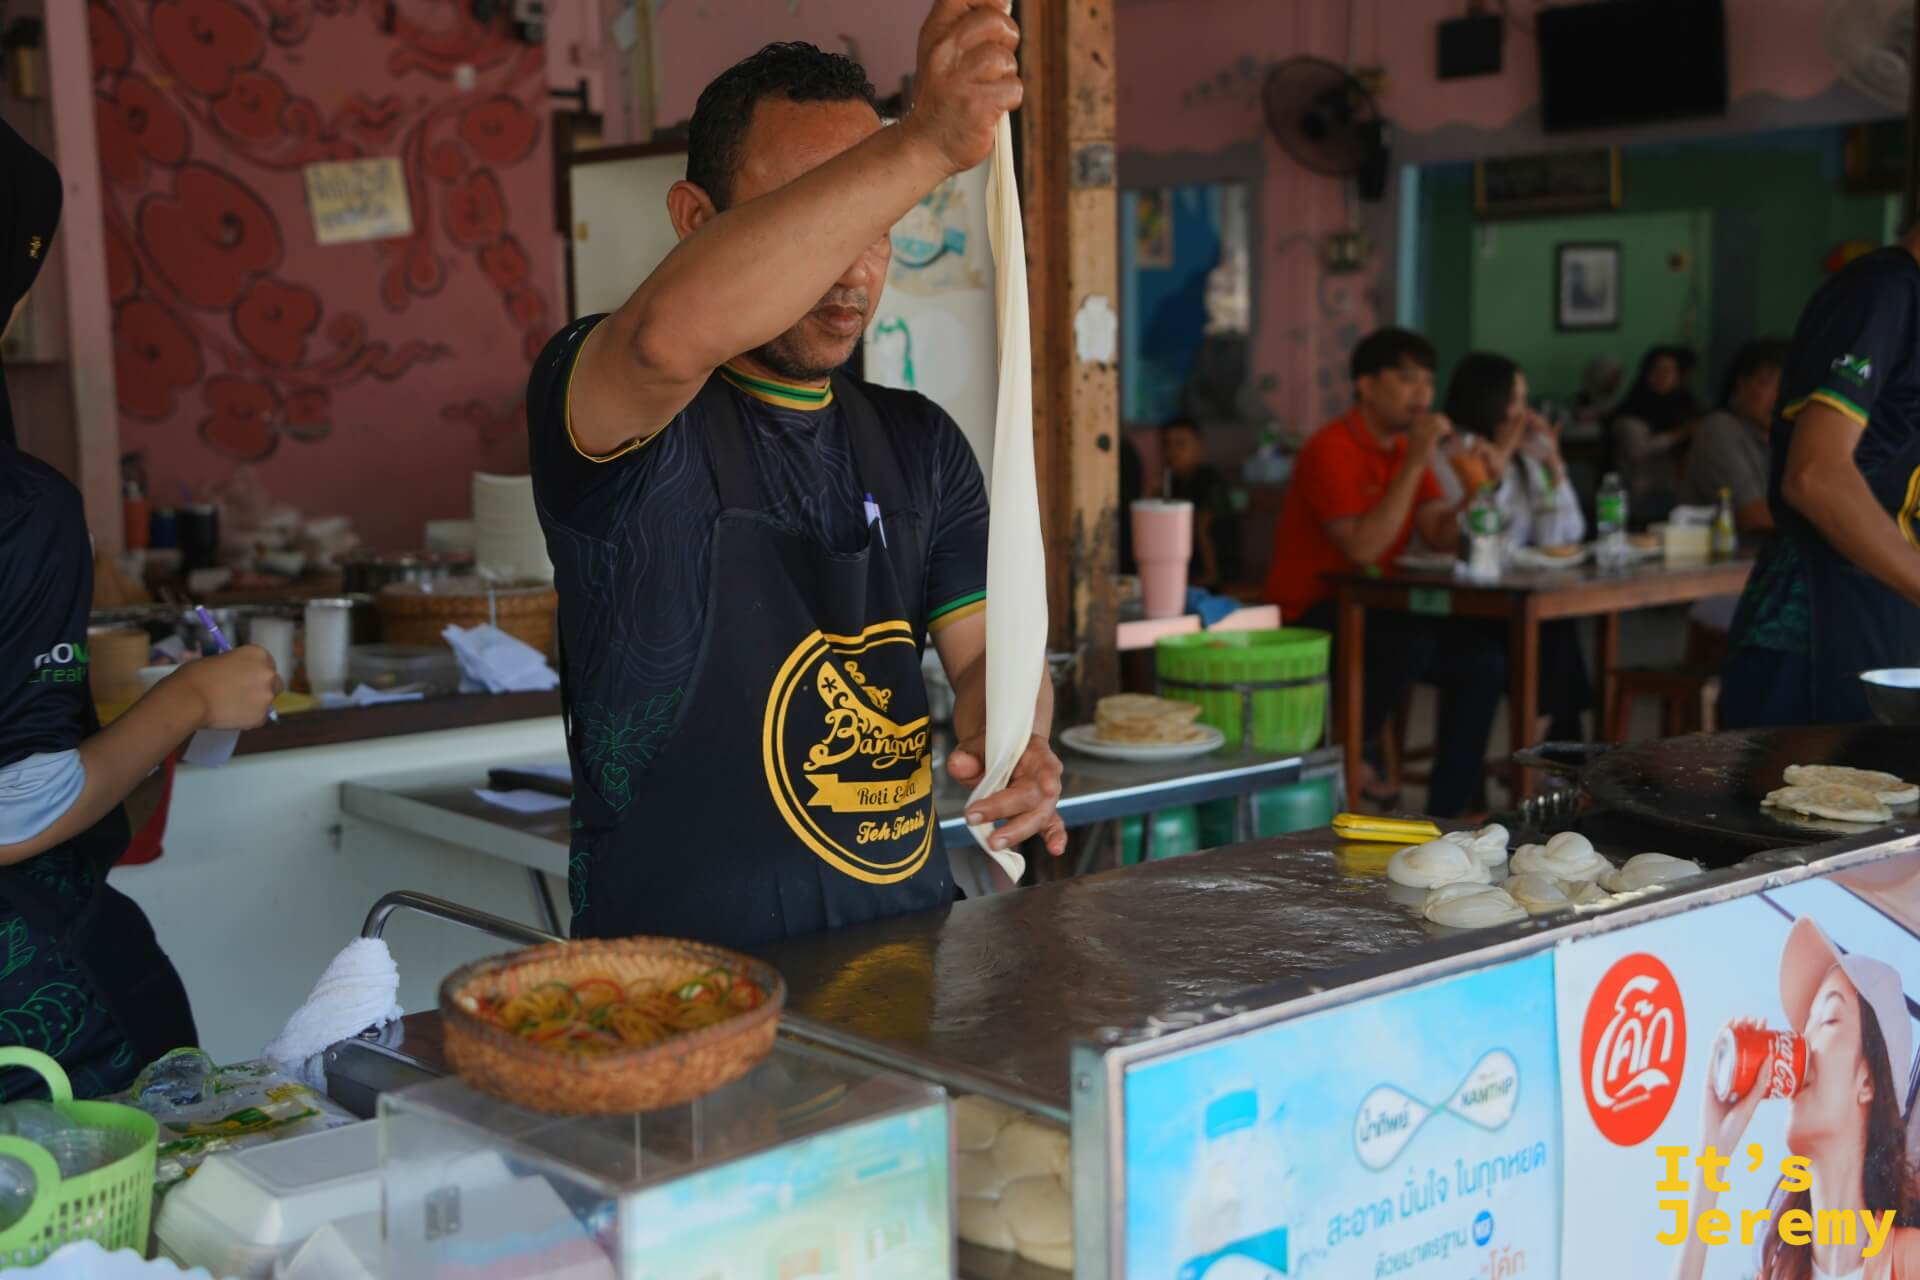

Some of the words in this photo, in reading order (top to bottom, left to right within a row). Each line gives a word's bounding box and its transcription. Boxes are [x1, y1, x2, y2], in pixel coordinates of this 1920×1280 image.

[857, 787, 888, 805] Roti
[856, 822, 890, 844] Teh
[892, 809, 925, 840] Tarik
[1327, 1198, 1393, 1246] สะอาด
[1400, 1166, 1448, 1217] มั่นใจ
[1456, 1141, 1546, 1198] ในทุกหยด
